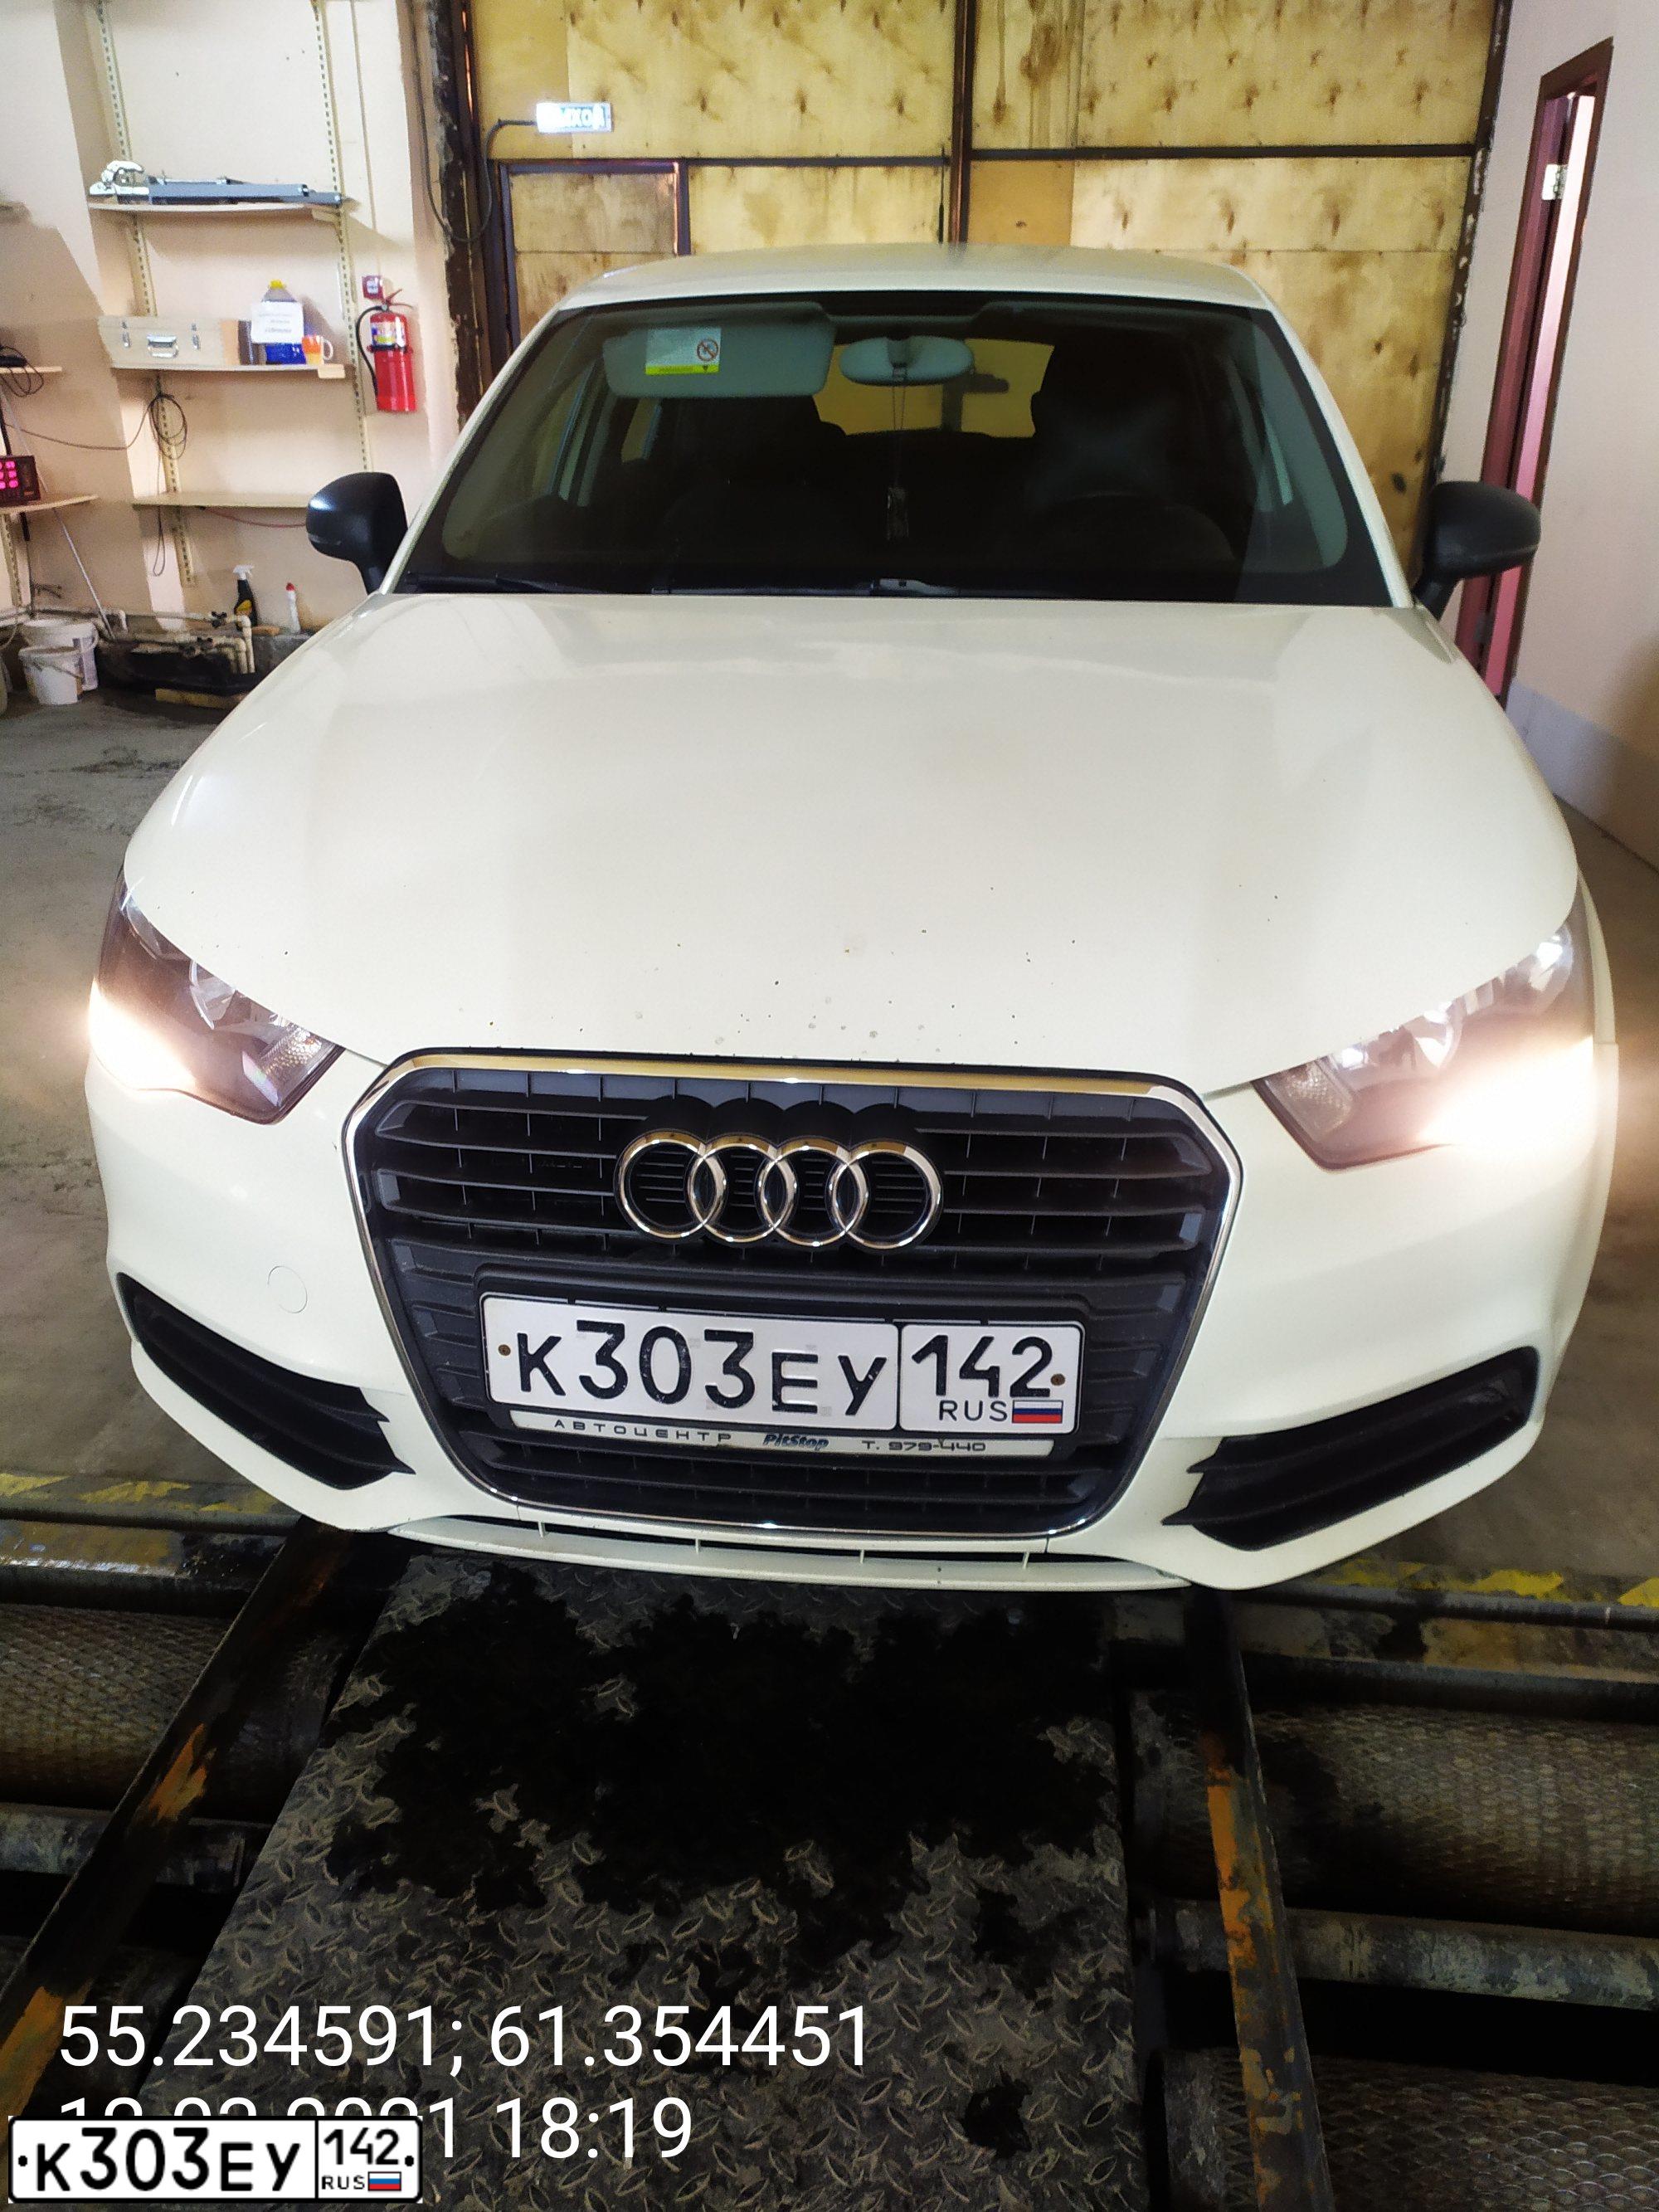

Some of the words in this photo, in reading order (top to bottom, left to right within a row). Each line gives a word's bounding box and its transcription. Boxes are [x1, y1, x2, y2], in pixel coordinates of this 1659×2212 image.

[517, 1319, 887, 1415] К303ЕУ
[912, 1334, 1052, 1397] 142
[939, 1401, 1008, 1422] RUS
[554, 1420, 732, 1442] АВТОЦЕНТР
[762, 1434, 830, 1451] PitStop
